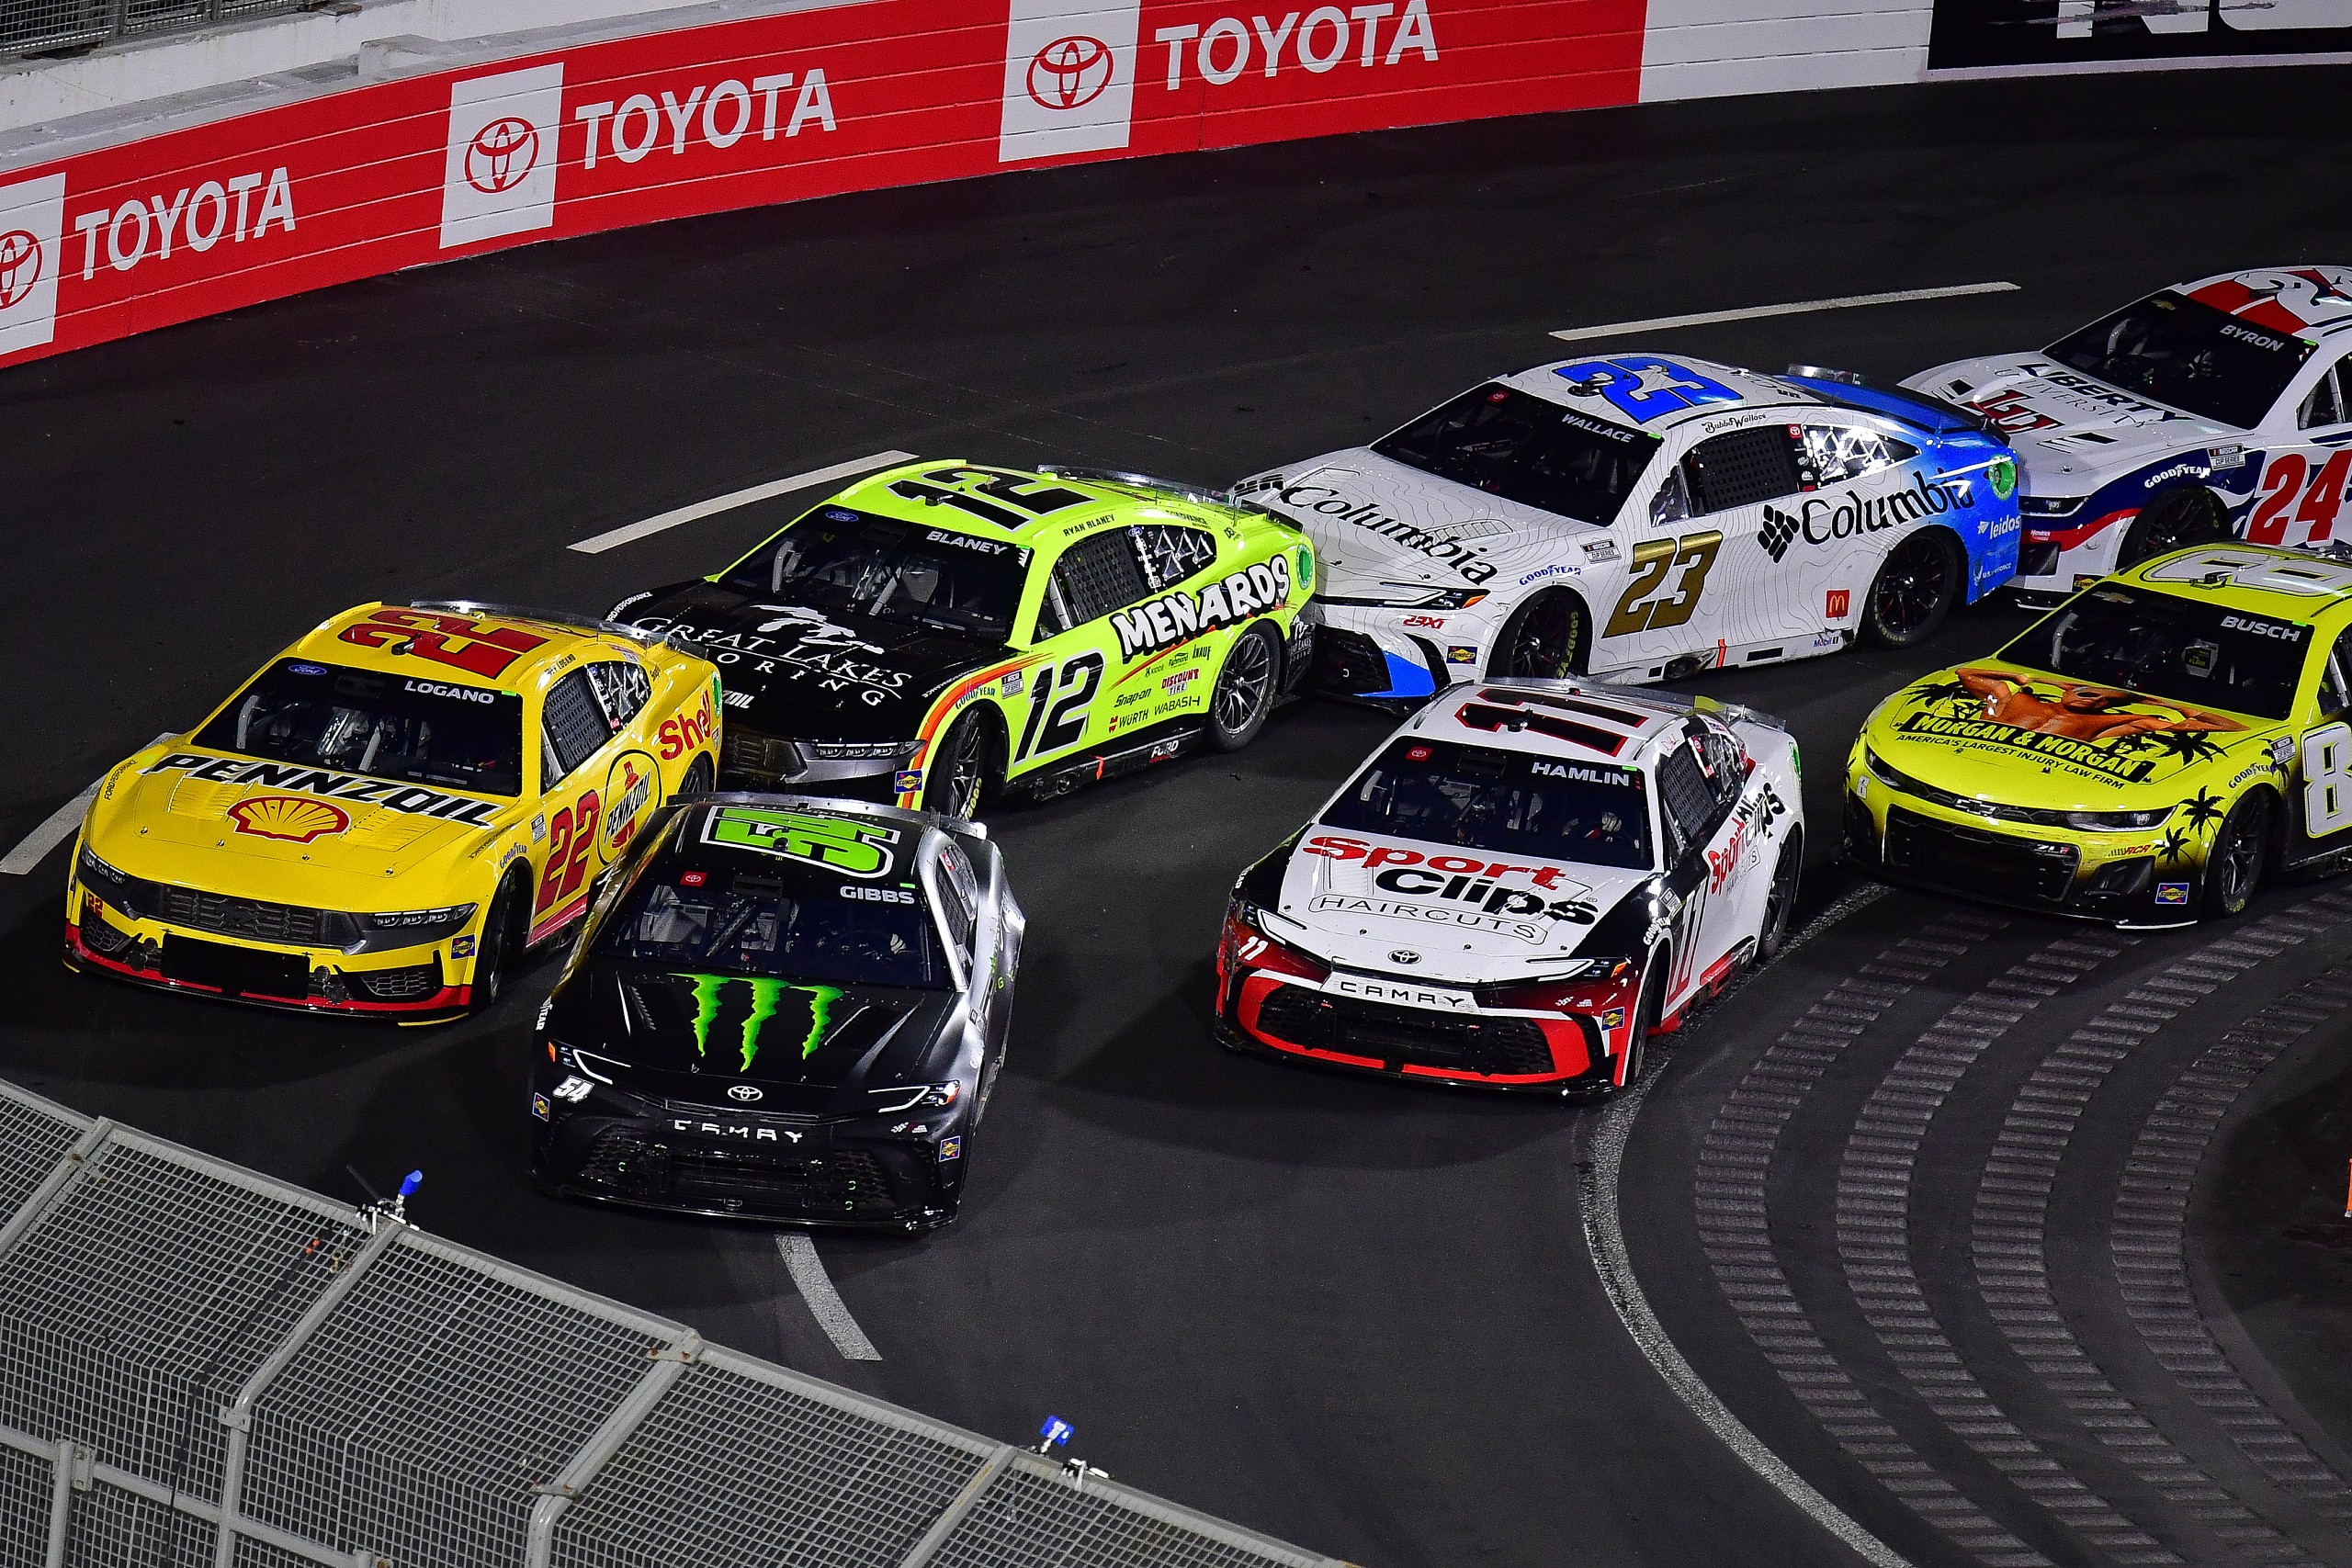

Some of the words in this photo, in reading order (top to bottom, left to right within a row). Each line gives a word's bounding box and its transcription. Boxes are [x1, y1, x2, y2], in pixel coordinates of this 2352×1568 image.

[1155, 0, 1439, 91] TOYOTA
[575, 67, 836, 170] TOYOTA
[74, 166, 296, 280] TOYOTA
[2220, 324, 2285, 352] BYRON
[1551, 356, 1745, 425] 23
[2016, 363, 2195, 422] LIBERTY
[1562, 413, 1634, 443] WALLACE
[1702, 418, 1734, 434] Bubba
[1731, 412, 1767, 428] Wallace
[885, 467, 1099, 533] 12
[1801, 468, 1975, 546] Columbia
[2246, 449, 2352, 545] 24
[829, 512, 853, 522] Ford
[1063, 522, 1085, 537] RYAN
[1085, 513, 1115, 531] BLANEY
[1990, 513, 2021, 540] leidos
[926, 530, 1008, 556] BLANEY
[1280, 486, 1498, 586] Columbia
[1519, 564, 1581, 586] GOODYEAR
[1601, 529, 1724, 638] 23
[1109, 554, 1291, 664] MENARDS
[2220, 615, 2301, 642] BUSCH
[336, 610, 552, 681] 22
[1192, 644, 1212, 660] KNAUF
[557, 653, 576, 670] LOGANO
[779, 644, 912, 688] LAKES
[1161, 668, 1199, 689] DISCOUNT
[1169, 683, 1186, 695] TIRE
[405, 681, 494, 705] LOGANO
[956, 682, 996, 709] GOODYEAR
[1114, 688, 1151, 708] Snap-on
[1154, 695, 1201, 716] WABASH
[1012, 649, 1105, 768] 12
[1119, 708, 1149, 728] WÜRTH
[1453, 687, 1650, 758] 11
[1915, 714, 2016, 741] MORGAN
[2013, 731, 2034, 746] &
[2035, 733, 2143, 777] MORGAN
[1532, 761, 1630, 787] HAMLIN
[1895, 734, 1962, 748] AMERICA'S
[1962, 739, 2018, 756] LARGEST
[2018, 750, 2064, 770] INJURY
[2063, 762, 2093, 779] LAW
[2091, 773, 2126, 790] FIRM
[2228, 761, 2273, 789] GOODYEA
[104, 780, 116, 800] FORD
[110, 759, 138, 784] PERFORMANCE
[141, 754, 504, 830] PENNZOIL
[897, 777, 921, 786] SUNOCO
[1857, 775, 1871, 800] 8
[2300, 722, 2352, 838] 8
[603, 770, 652, 845] PENNZOIL
[499, 841, 528, 869] GOODYEAR
[535, 788, 600, 917] 22
[700, 806, 901, 878] 54
[1303, 836, 1566, 890] Sport
[86, 893, 104, 919] 22
[840, 886, 915, 905] GIBBS
[1375, 868, 1600, 925] Clips
[2158, 890, 2187, 898] SUNOCO
[1319, 897, 1537, 940] HAIRCUTS
[1238, 935, 1269, 961] 11
[1340, 980, 1465, 1008] CAMRY
[552, 1075, 595, 1103] 54
